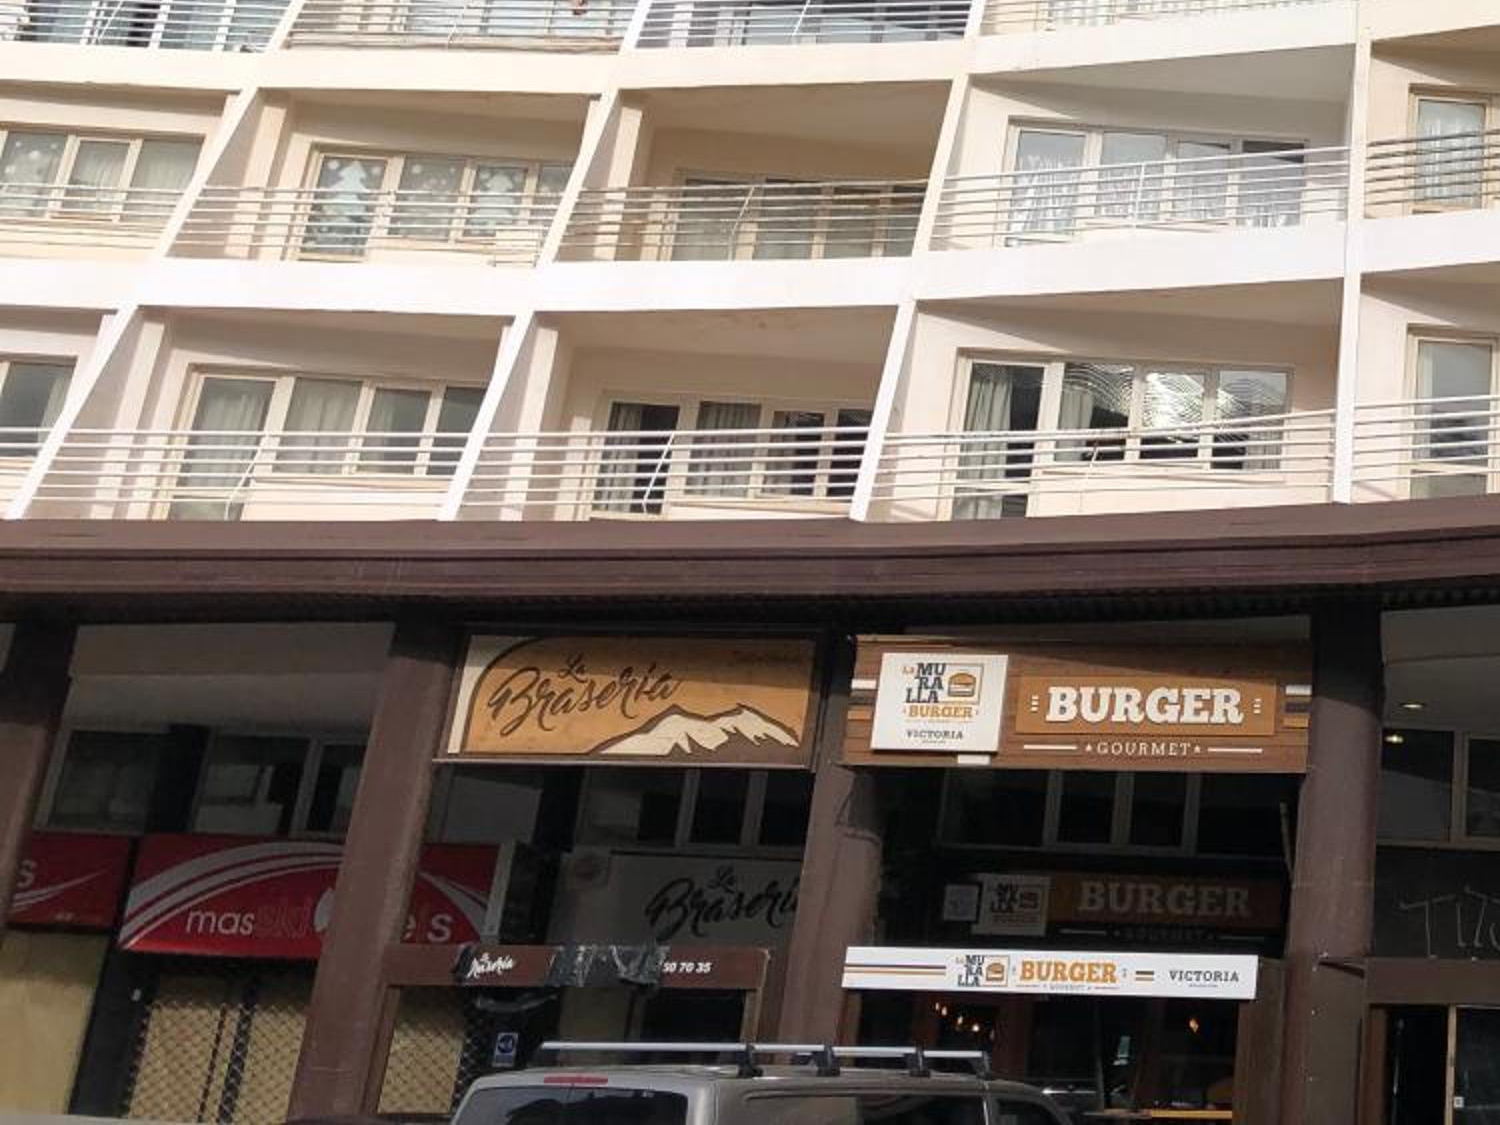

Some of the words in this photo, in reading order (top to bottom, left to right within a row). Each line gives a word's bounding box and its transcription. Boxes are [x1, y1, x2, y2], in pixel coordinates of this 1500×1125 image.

[908, 704, 973, 718] BURGER
[1045, 686, 1244, 724] BURGER
[906, 730, 963, 740] VICTORIA
[1096, 742, 1191, 756] GOURMET
[1076, 879, 1251, 919] BURGER
[1020, 960, 1118, 984] BURGER
[1169, 969, 1240, 982] VICTORIA
